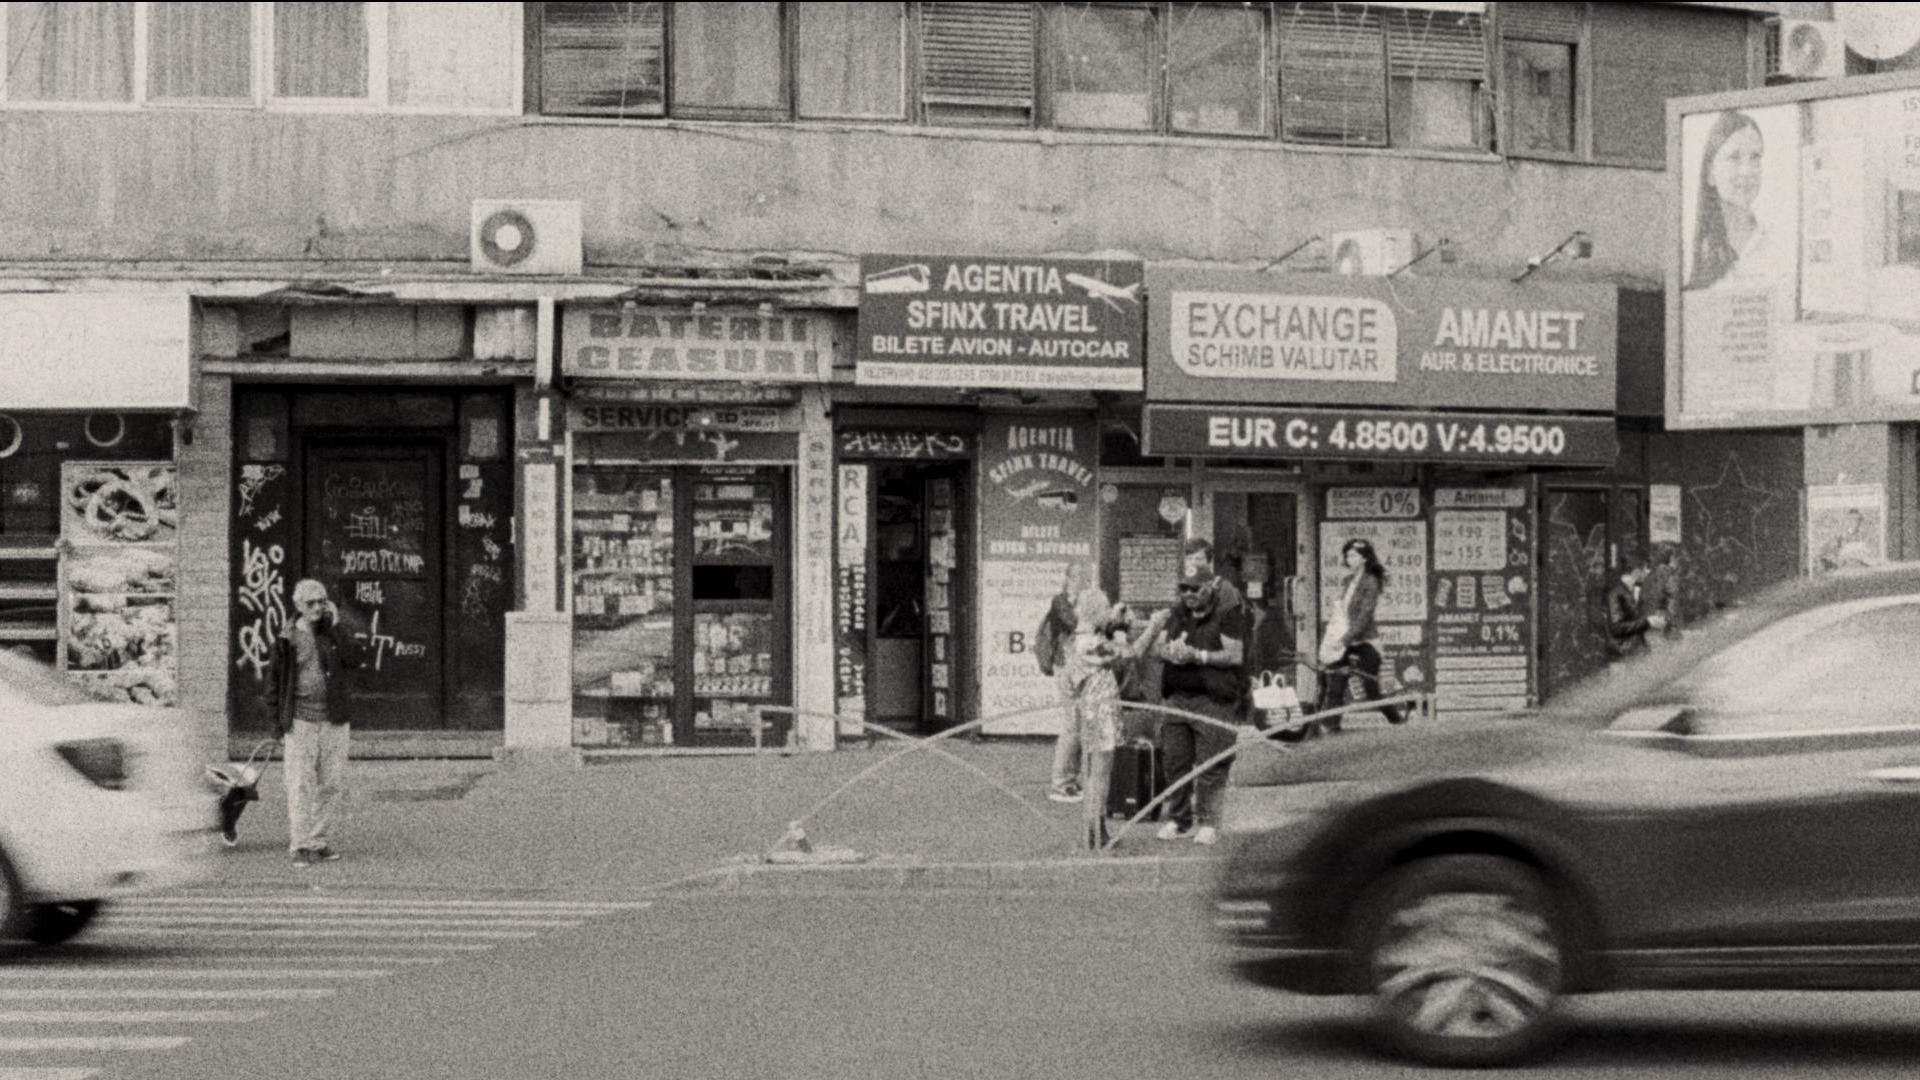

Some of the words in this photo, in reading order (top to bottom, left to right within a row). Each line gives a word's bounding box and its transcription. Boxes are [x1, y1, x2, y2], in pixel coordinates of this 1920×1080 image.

[943, 264, 1063, 294] AGENTIA
[907, 300, 987, 329] SFINX
[992, 303, 1097, 332] TRAVEL
[1188, 302, 1378, 343] EXCHANGE
[1435, 308, 1584, 350] AMANET
[872, 335, 944, 355] BILETE
[949, 338, 1013, 356] AVION
[1029, 339, 1129, 358] AUTOCAR
[1188, 344, 1275, 370] SCHIMB
[1281, 346, 1378, 372] VALUTAR
[1420, 352, 1456, 372] AUR
[1461, 354, 1475, 372] &
[1477, 354, 1599, 376] ELECTRONICE
[1008, 426, 1073, 451] AGENTIA
[1209, 417, 1277, 448] EUR
[1285, 419, 1319, 448] C:
[1329, 421, 1429, 452] 4.8500
[843, 469, 860, 544] RCA
[1380, 491, 1415, 515] 0%
